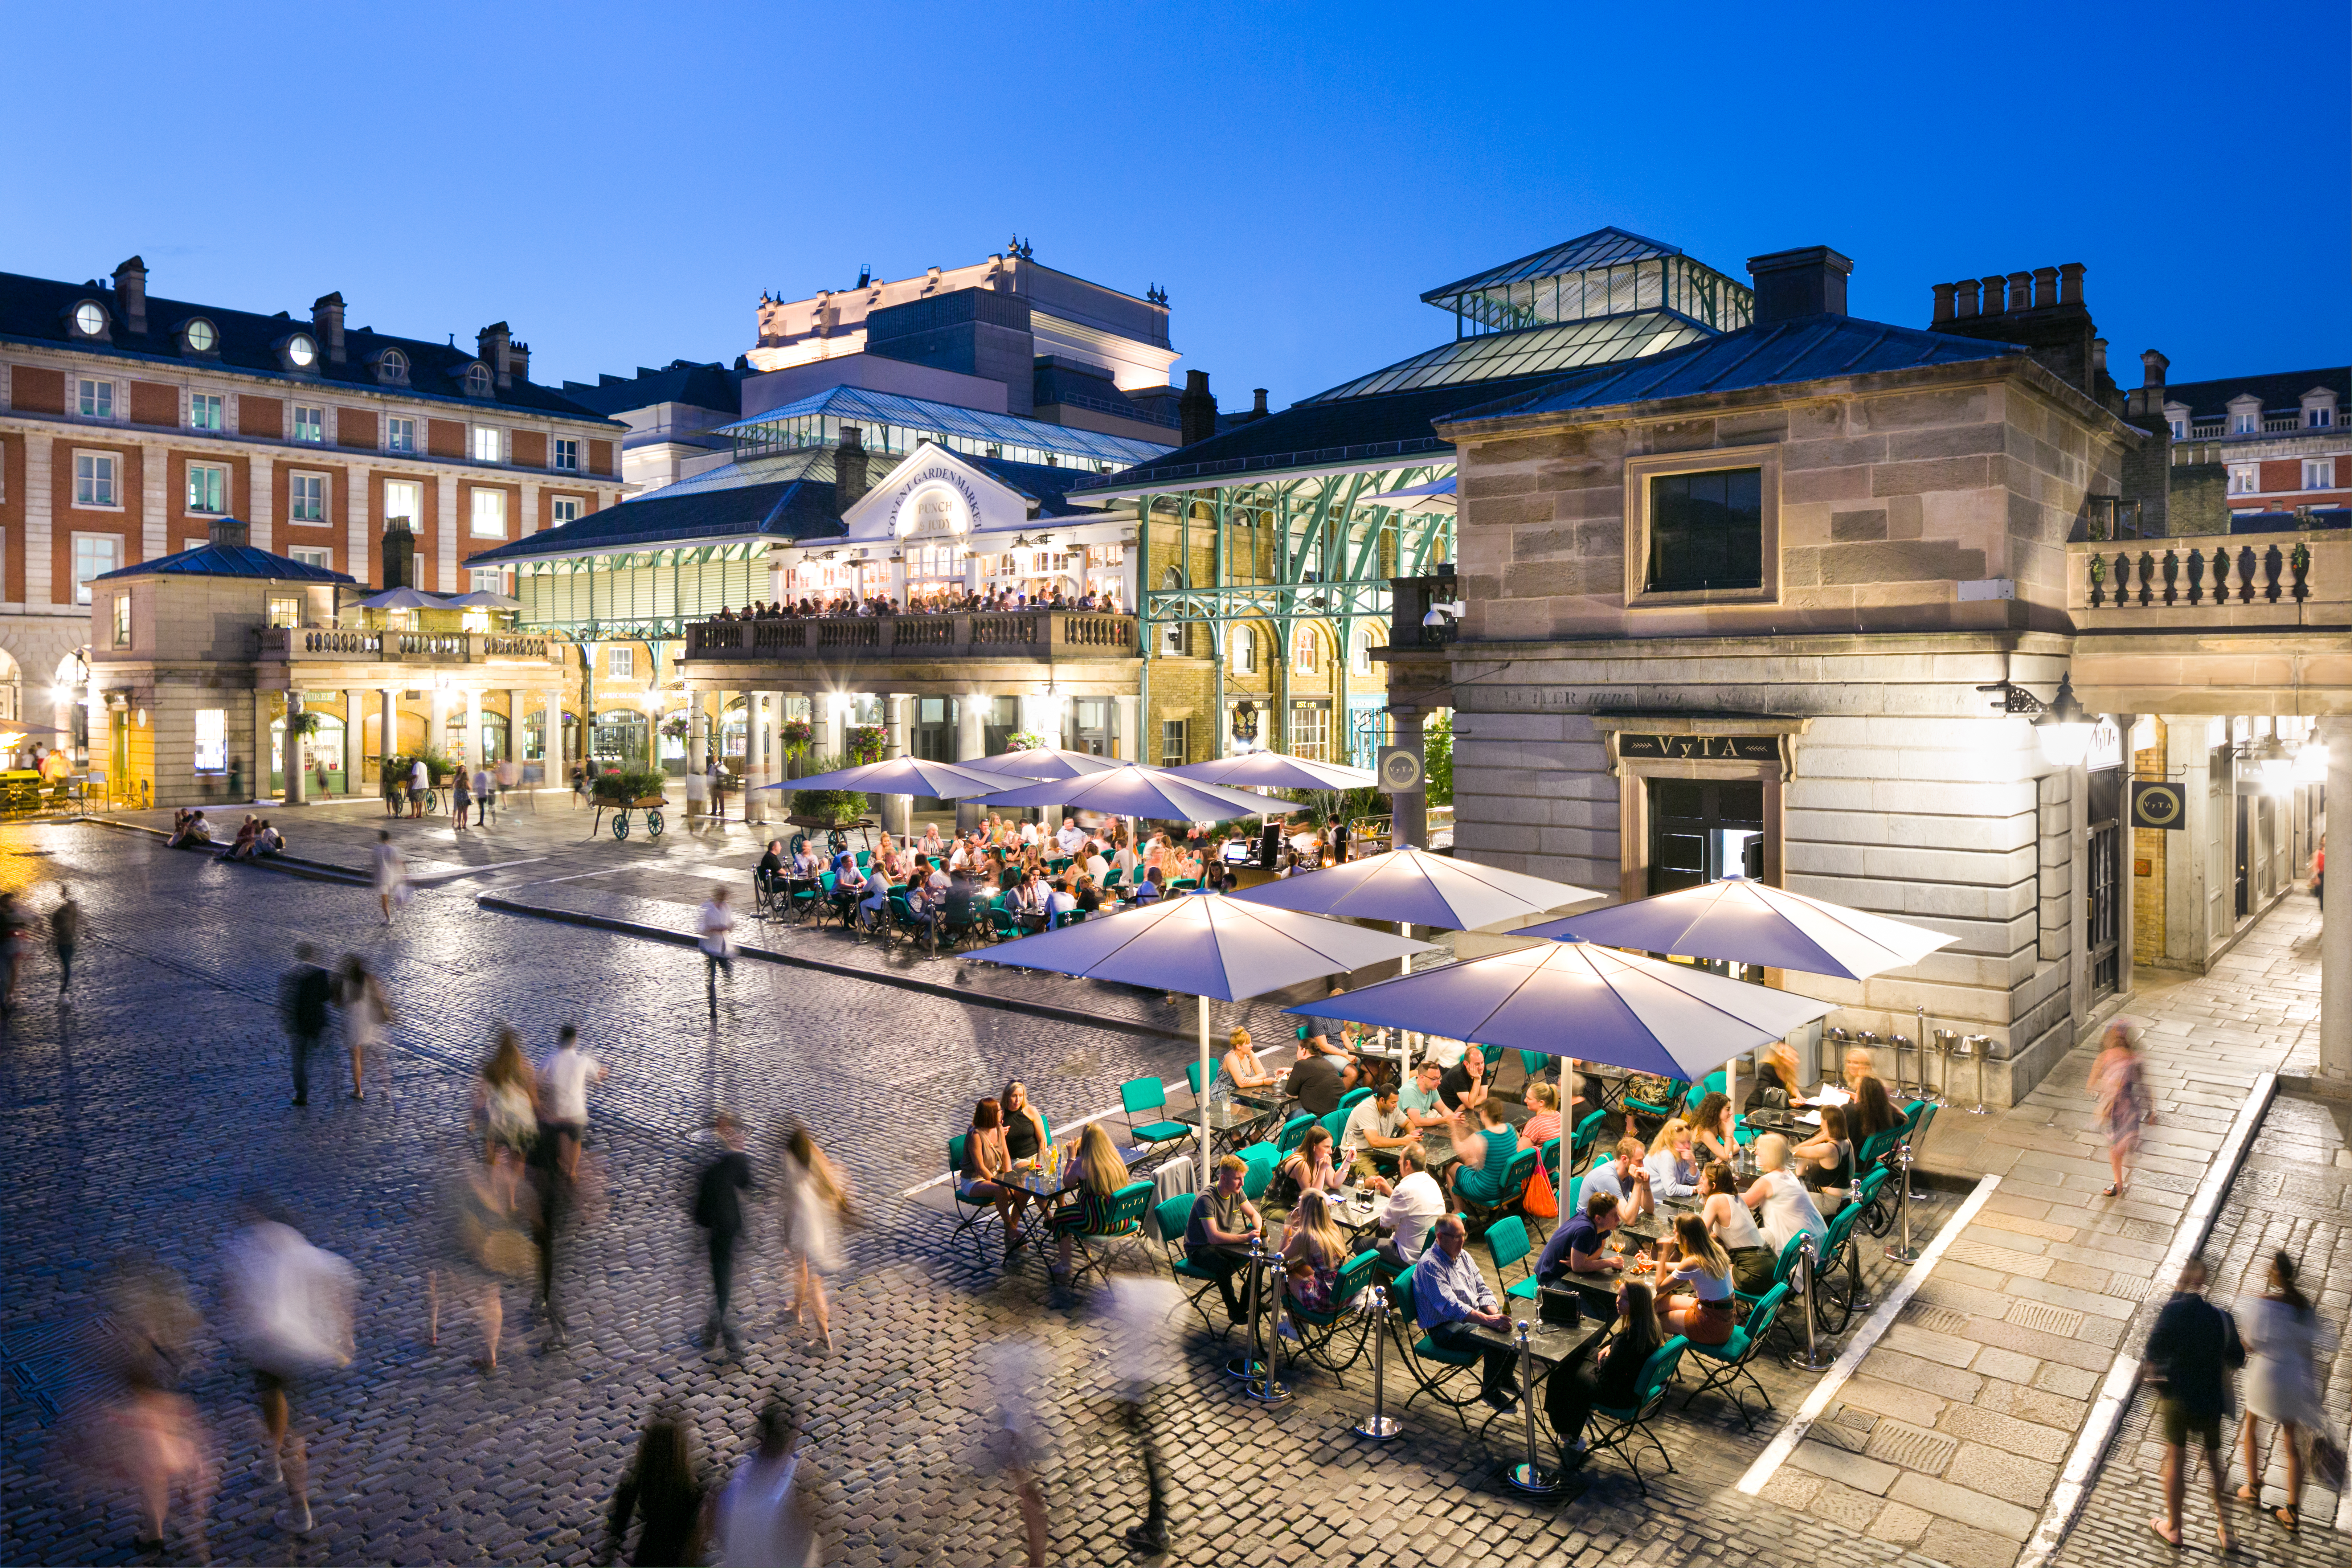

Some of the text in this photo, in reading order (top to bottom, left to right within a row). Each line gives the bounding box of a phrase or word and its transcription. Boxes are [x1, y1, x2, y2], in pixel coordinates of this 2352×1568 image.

[888, 467, 982, 537] COVENT GARDEN MARKET
[918, 501, 952, 515] PUNCH
[918, 519, 952, 533] & JUDY
[1656, 736, 1740, 758] VyTA
[1489, 1047, 1501, 1056] VyTA
[1587, 1125, 1599, 1136] VyTA
[1515, 1162, 1532, 1175] VyTA
[1122, 1197, 1144, 1210] VyTA
[1350, 1268, 1369, 1286] VyTA
